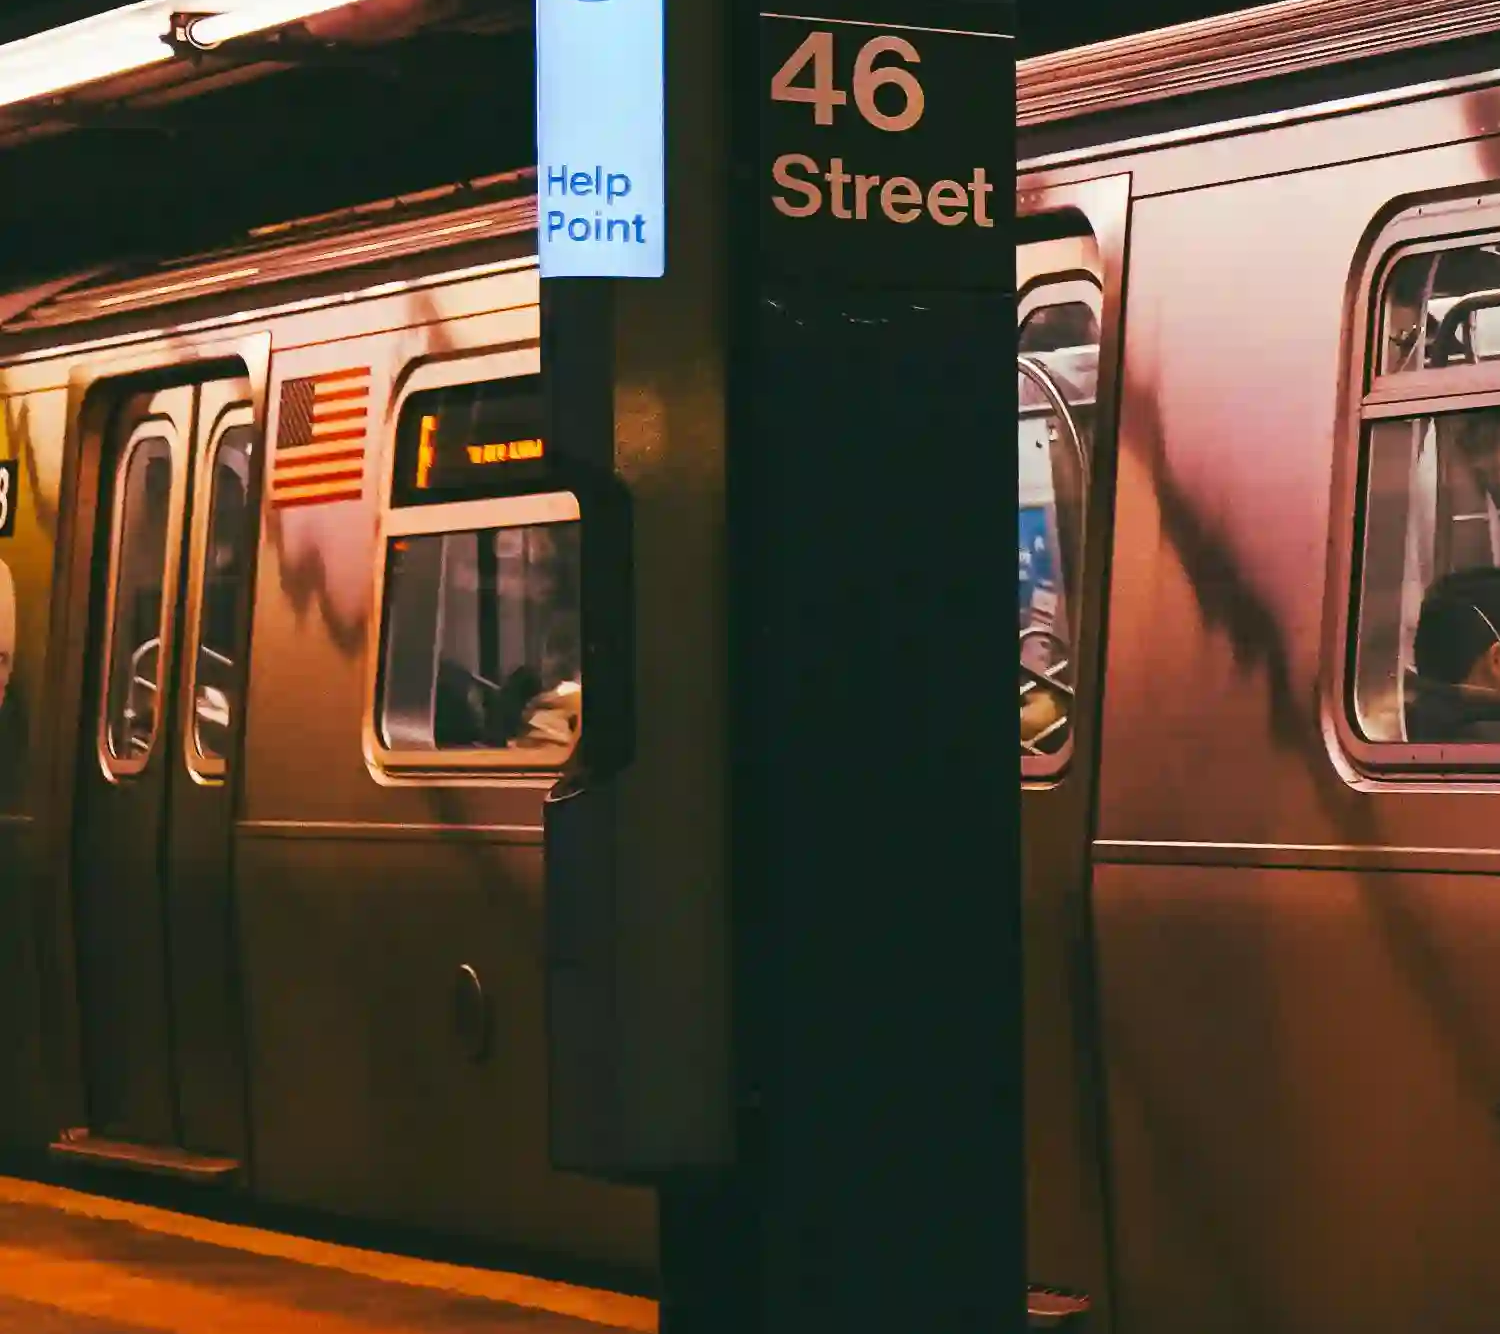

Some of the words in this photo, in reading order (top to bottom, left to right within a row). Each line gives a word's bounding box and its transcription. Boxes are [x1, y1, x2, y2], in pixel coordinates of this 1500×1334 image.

[769, 30, 925, 132] 46
[546, 164, 633, 205] Help
[771, 152, 995, 228] Street
[546, 210, 647, 245] Point
